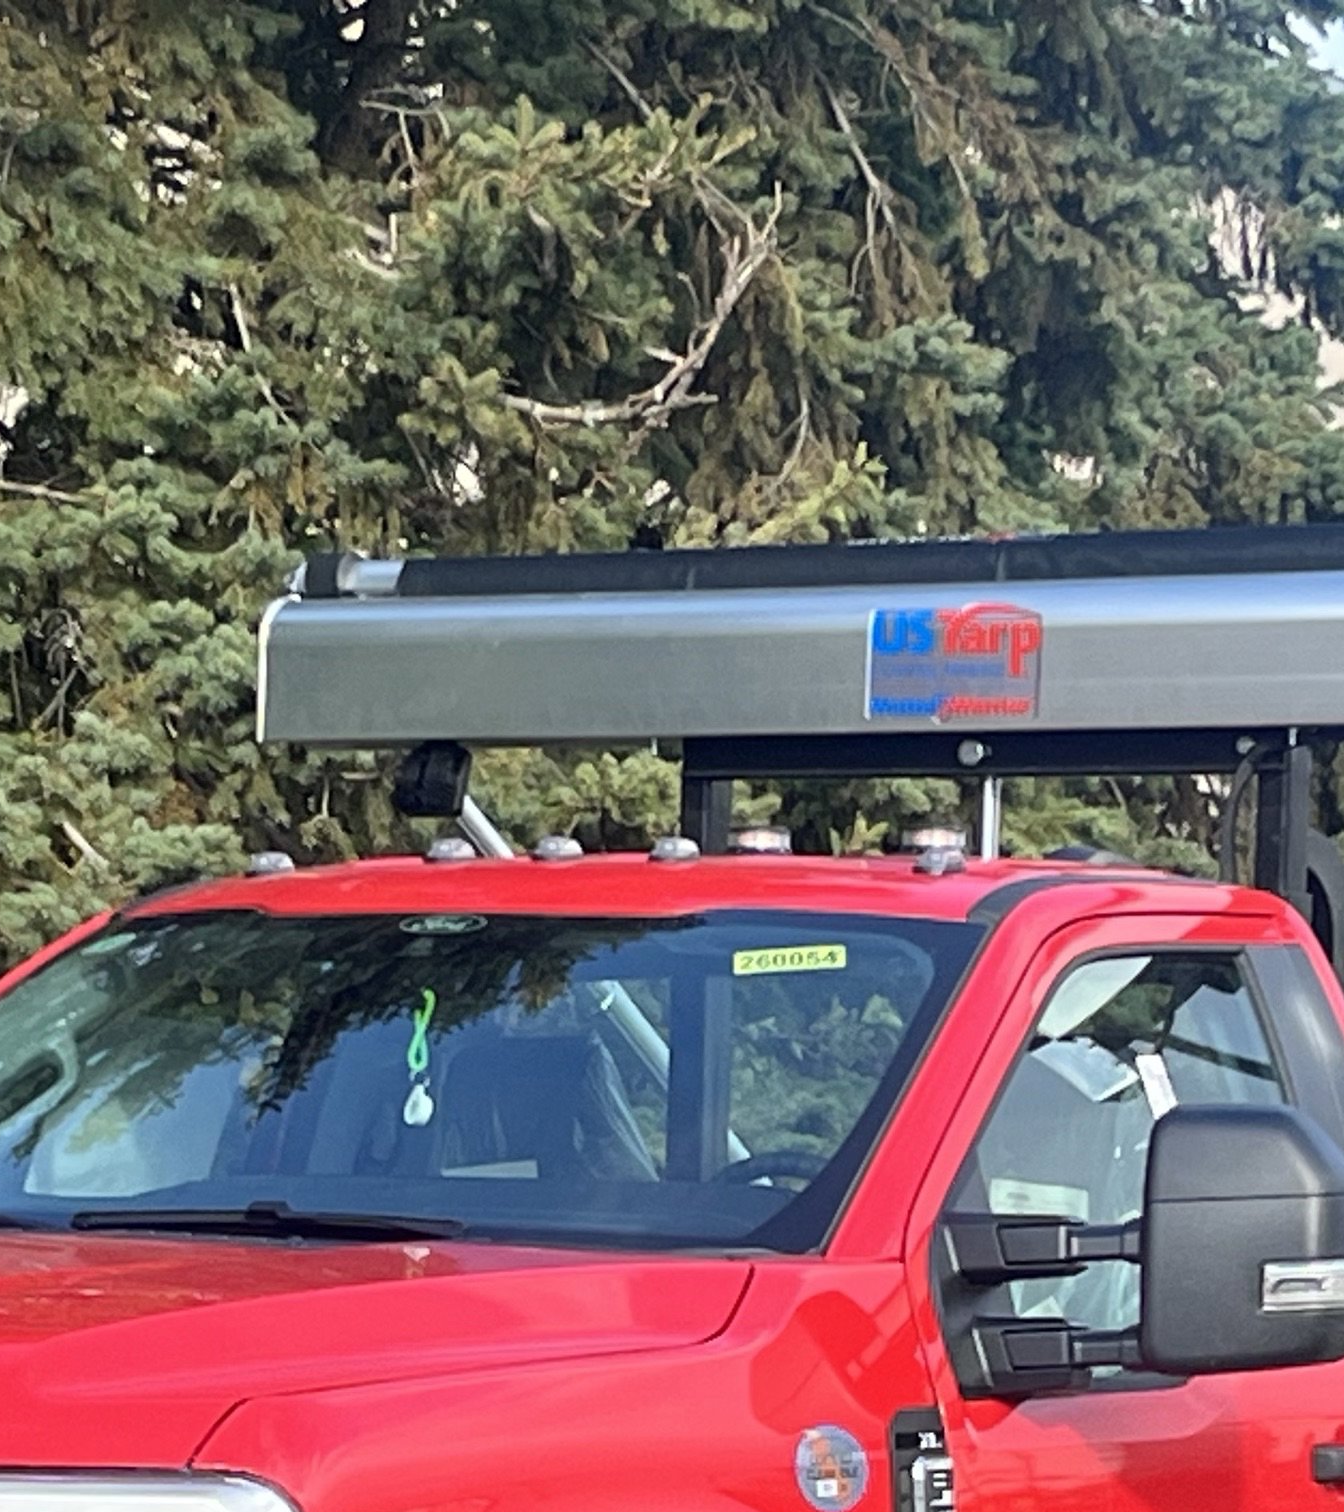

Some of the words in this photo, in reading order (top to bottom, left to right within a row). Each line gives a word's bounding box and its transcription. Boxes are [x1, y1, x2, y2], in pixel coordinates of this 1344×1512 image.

[873, 609, 935, 654] US
[936, 608, 1042, 677] Tarp
[740, 950, 840, 970] 260054
